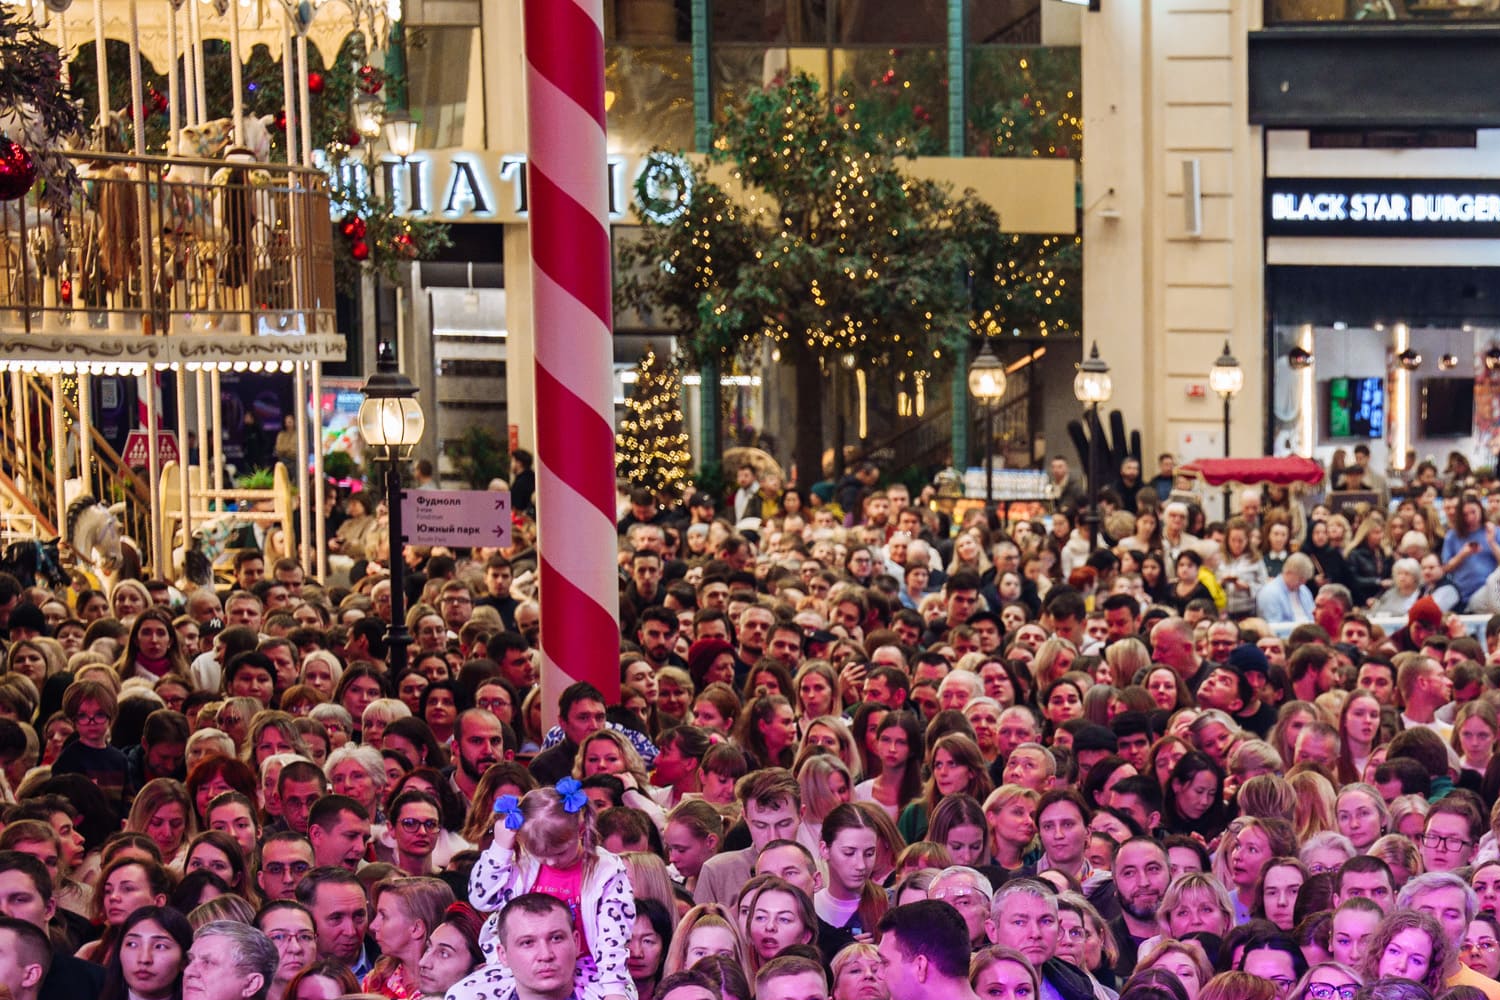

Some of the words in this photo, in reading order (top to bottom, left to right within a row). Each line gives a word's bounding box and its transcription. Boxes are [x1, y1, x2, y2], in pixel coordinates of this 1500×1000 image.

[1272, 193, 1347, 220] BLACK
[1349, 194, 1410, 221] STAR
[416, 496, 461, 506] Фудмолл
[417, 524, 455, 533] Южный
[457, 525, 480, 535] парк
